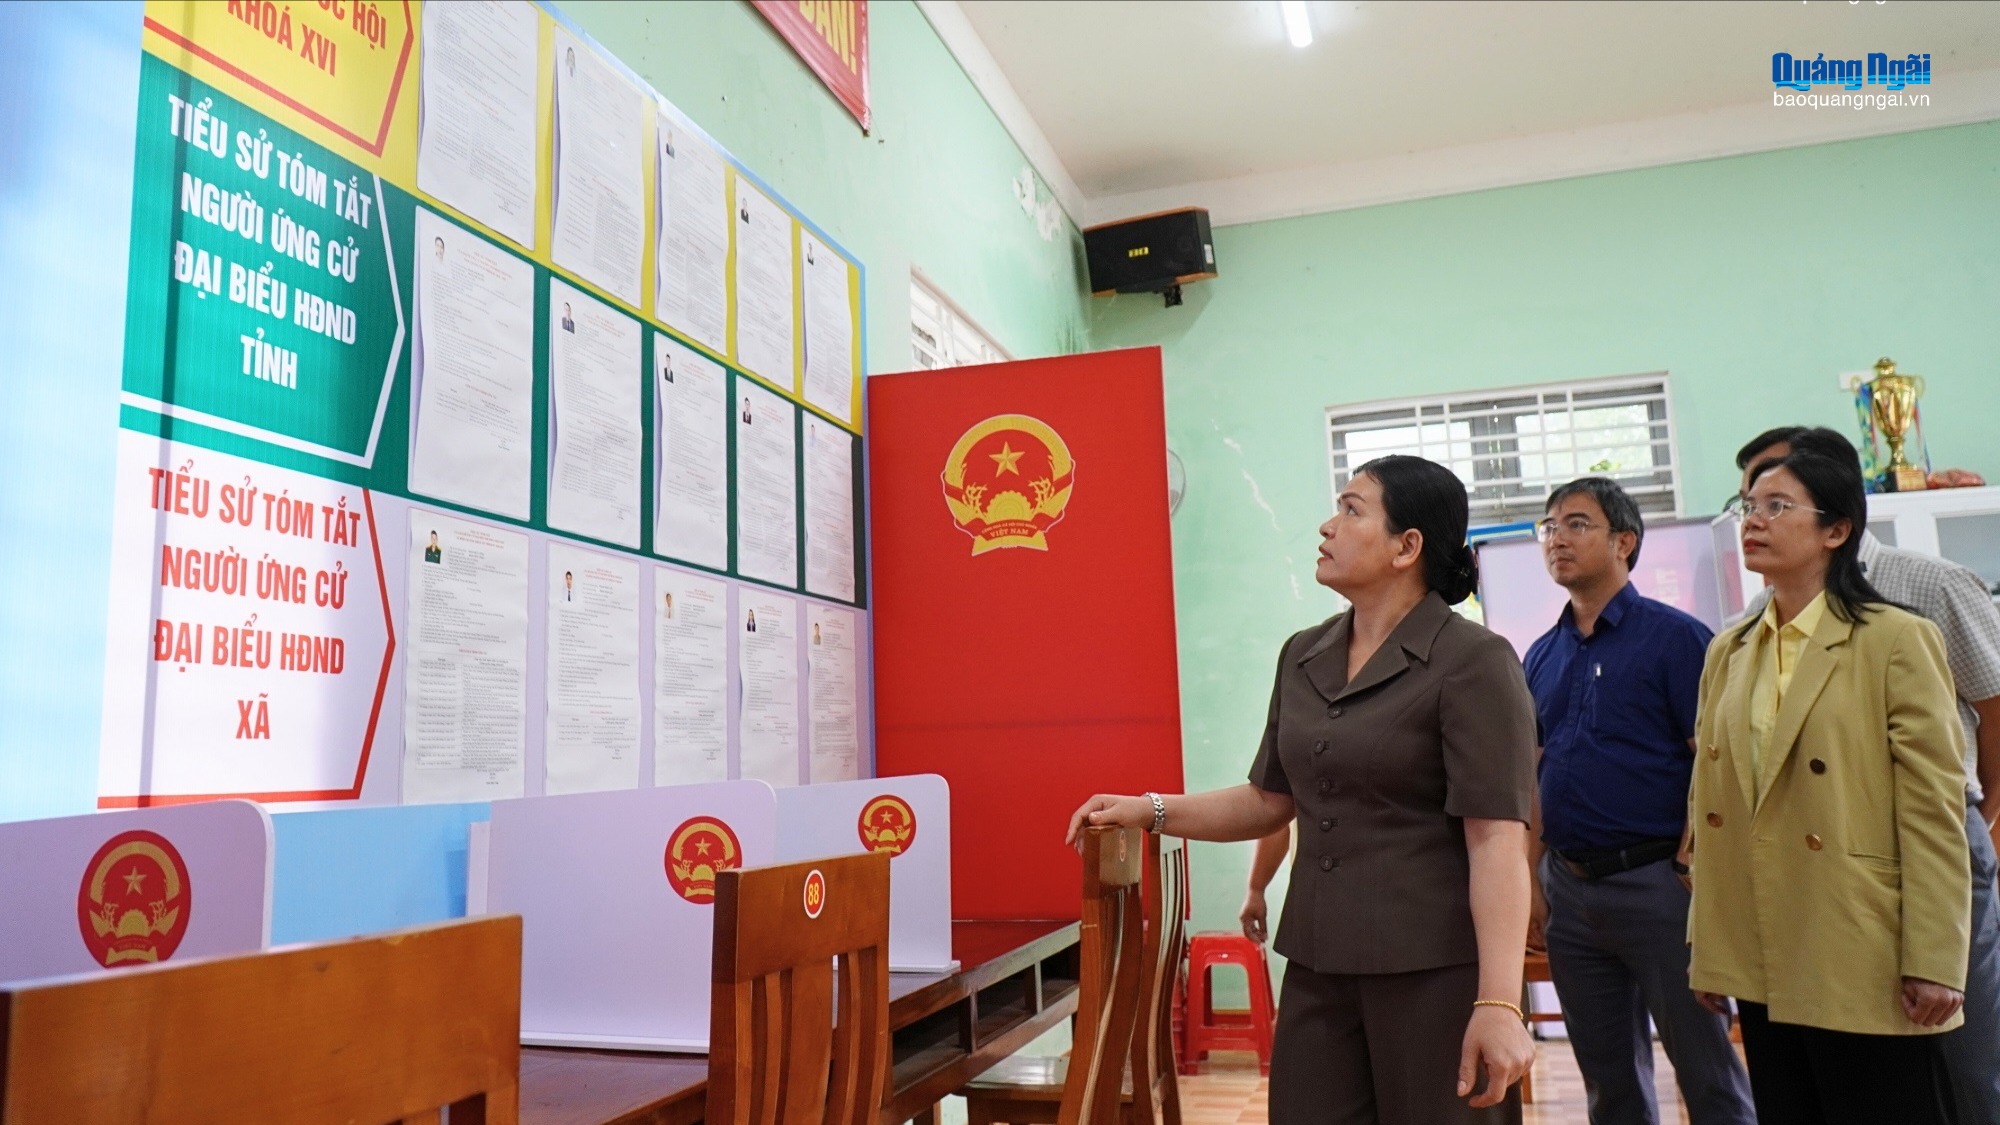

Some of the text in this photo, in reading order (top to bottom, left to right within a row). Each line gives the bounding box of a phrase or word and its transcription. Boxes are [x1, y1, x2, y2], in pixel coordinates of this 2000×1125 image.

[300, 23, 336, 77] XVI
[352, 0, 386, 50] HỘI
[168, 94, 372, 230] TIỂU SỬ TÓM TẮT
[181, 171, 360, 284] NGƯỜI ỨNG CỬ
[174, 240, 356, 345] ĐẠI BIỂU HĐND
[240, 327, 298, 390] TỈNH
[148, 459, 361, 548] TIỂU SỬ TÓM TẮT
[161, 544, 348, 610] NGƯỜI ỨNG CỬ
[153, 612, 345, 675] ĐẠI BIỂU HĐND
[235, 693, 271, 740] XÃ
[808, 882, 820, 906] 88
